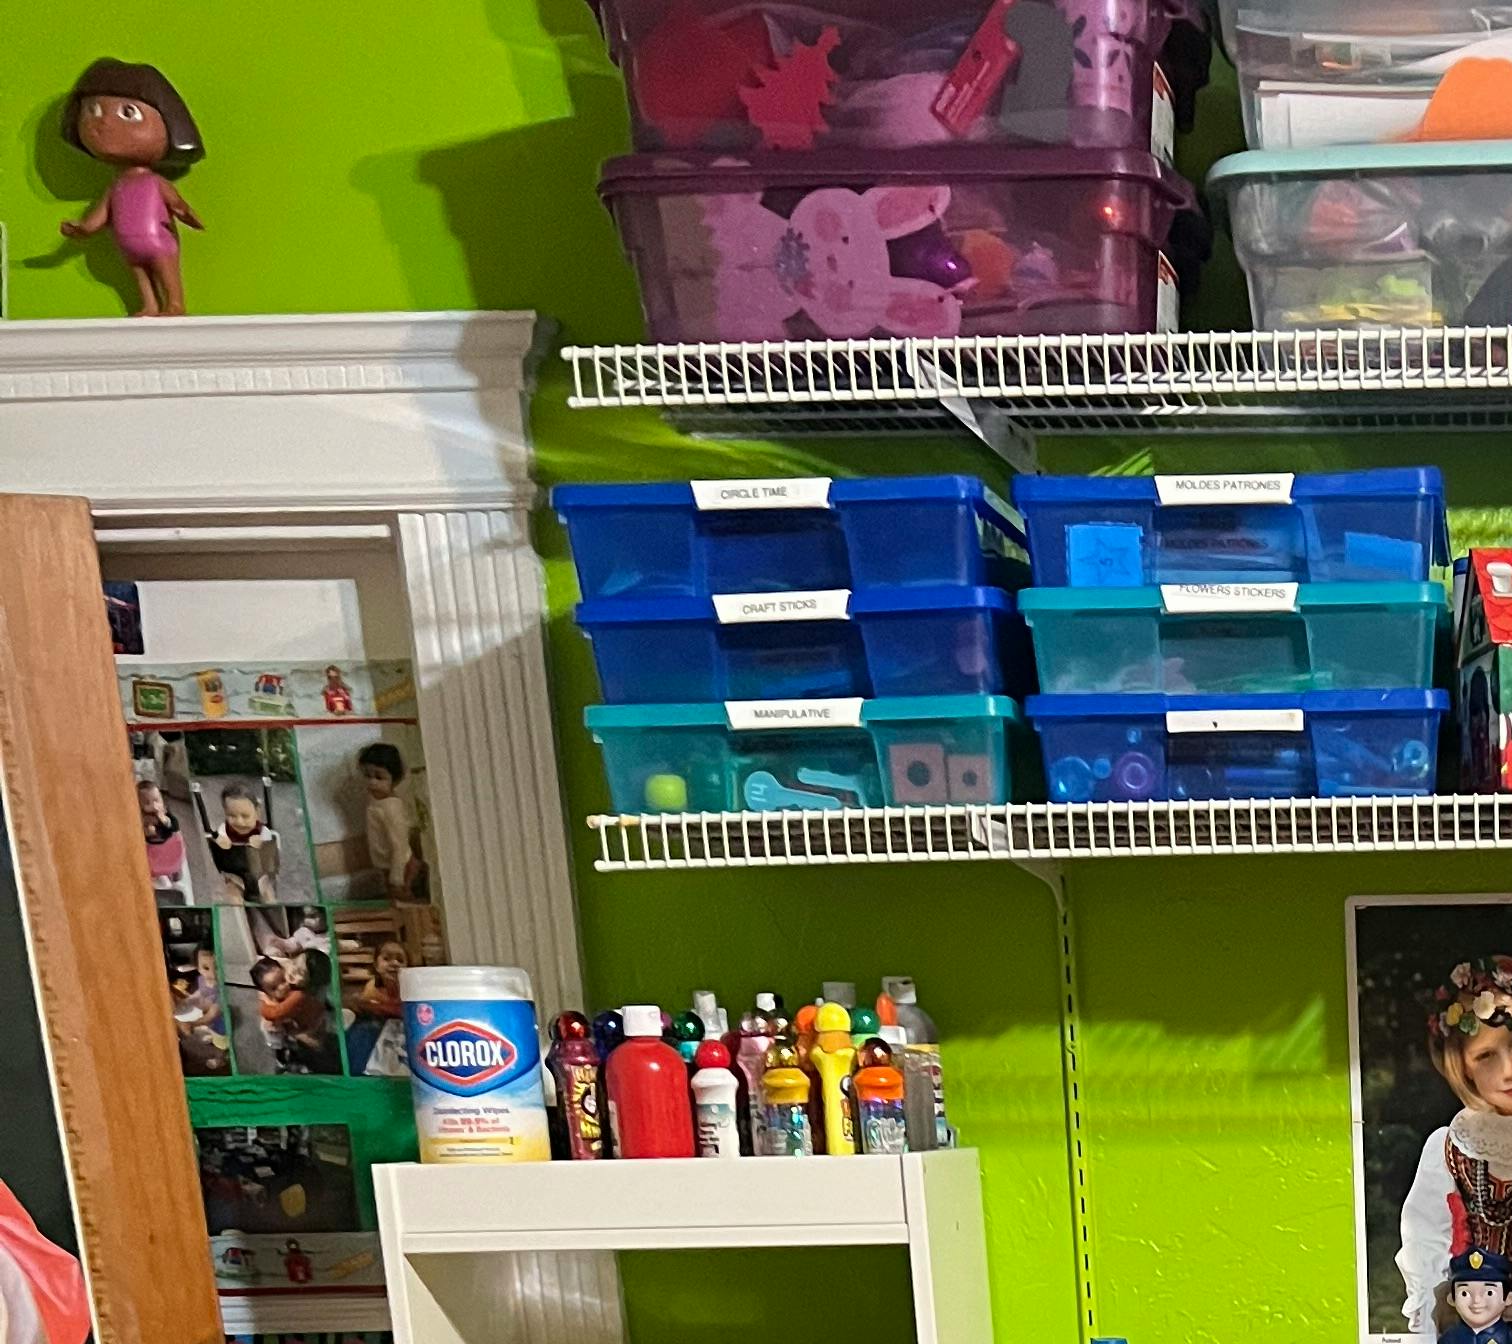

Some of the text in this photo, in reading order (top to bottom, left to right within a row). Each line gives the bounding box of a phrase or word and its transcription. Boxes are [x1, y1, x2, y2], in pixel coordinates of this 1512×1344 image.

[1175, 480, 1281, 490] MOLDES PATRONES
[720, 486, 787, 499] CIRCLE TIME
[1233, 586, 1286, 599] STICKERS
[742, 599, 817, 615] CRAFT STICKS
[754, 708, 831, 720] MANIPULATIVE
[425, 1039, 505, 1068] CLOROX
